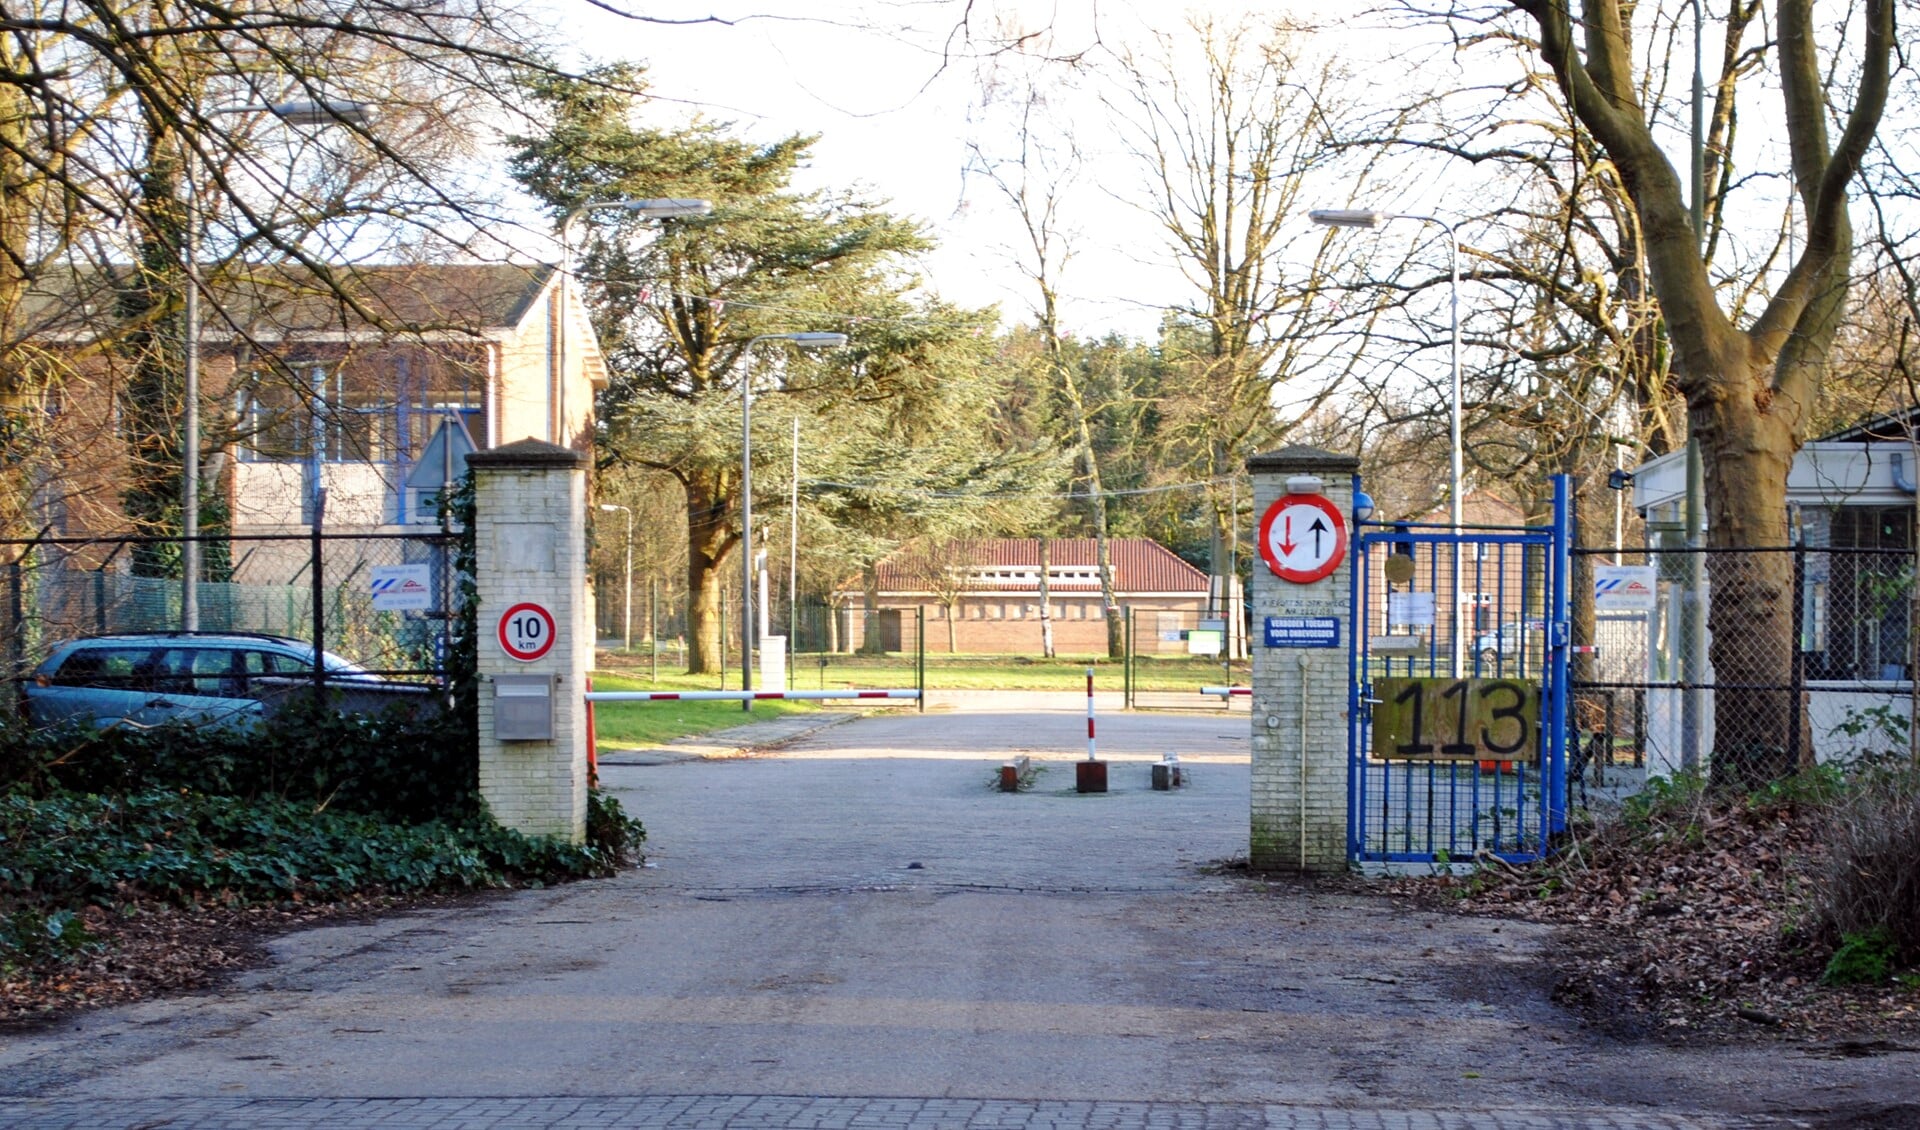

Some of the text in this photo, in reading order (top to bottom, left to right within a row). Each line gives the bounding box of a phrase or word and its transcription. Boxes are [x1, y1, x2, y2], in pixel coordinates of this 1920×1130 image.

[512, 617, 541, 638] 10
[1270, 619, 1334, 628] VERBODEN TOEGANG
[1270, 629, 1335, 638] VOOR ONBEVOEGDEN
[518, 640, 536, 649] km
[1395, 681, 1528, 755] 113
